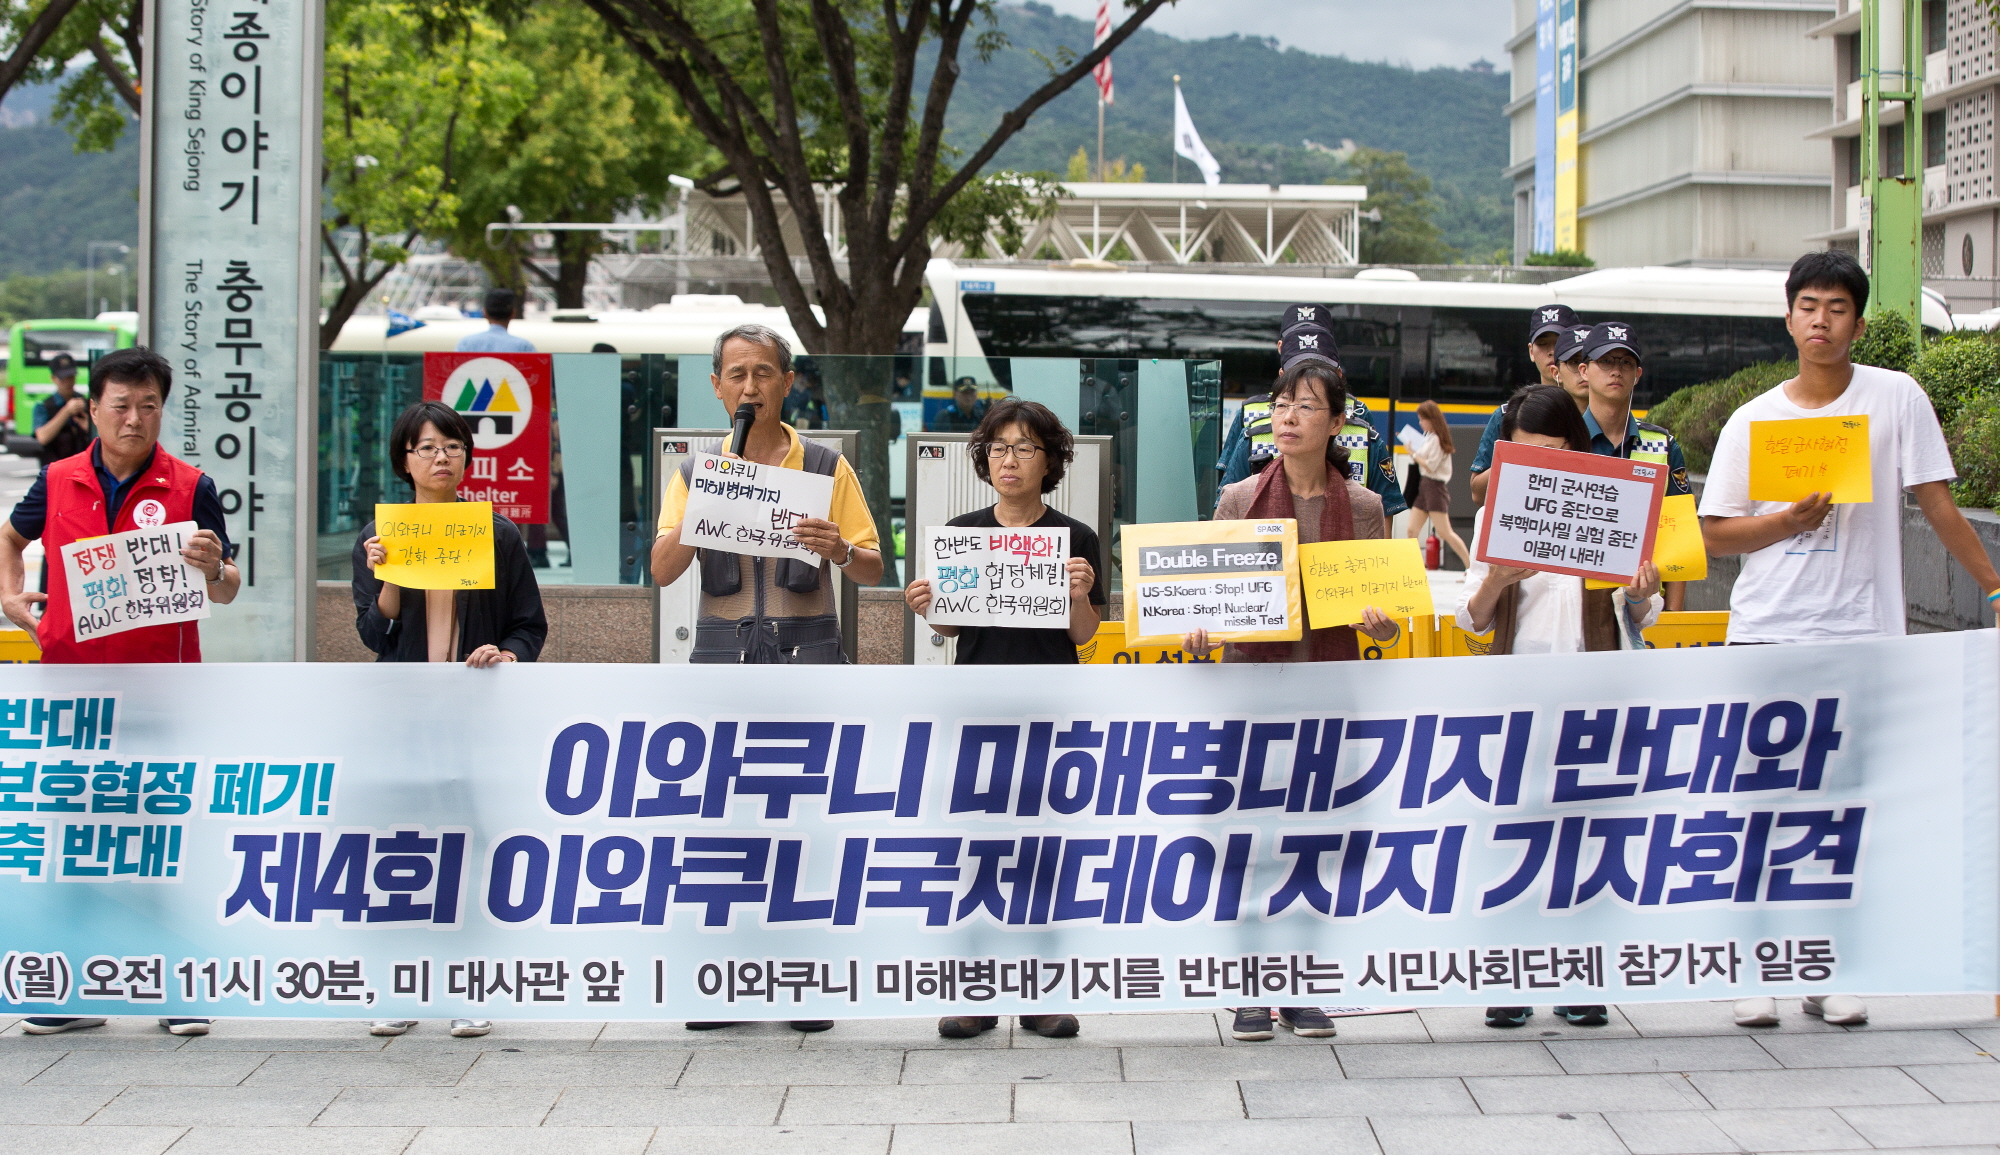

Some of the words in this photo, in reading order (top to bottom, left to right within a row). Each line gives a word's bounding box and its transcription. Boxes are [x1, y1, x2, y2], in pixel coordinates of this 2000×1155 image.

[190, 53, 207, 73] of
[185, 80, 206, 120] King
[219, 0, 269, 225] 종이야기
[183, 128, 205, 191] Sejong
[185, 259, 203, 294] The
[181, 301, 202, 352] Story
[184, 358, 201, 379] of
[183, 384, 201, 457] Admiral
[704, 458, 757, 481] 이와쿠니
[695, 478, 781, 504] 미해병대기지
[1528, 473, 1557, 494] 한미
[1561, 478, 1619, 502] 군사연습
[1525, 496, 1557, 515] UFG
[1561, 501, 1619, 523] 중단으로
[381, 521, 432, 539] 이와쿠니
[695, 518, 732, 539] AWC
[1257, 525, 1283, 533] SPARK
[1499, 513, 1571, 540] 북핵미사일
[1575, 525, 1604, 545] 실험
[1608, 529, 1638, 549] 중단
[72, 543, 117, 576] 전쟁
[399, 547, 427, 566] 강화
[934, 536, 982, 559] 한반도
[989, 533, 1062, 566] 비핵화!
[1145, 549, 1207, 570] Double
[1213, 548, 1278, 567] Freeze
[1523, 540, 1567, 560] 이끌어
[1569, 548, 1605, 567] 내라!
[82, 573, 127, 609] 평화
[133, 564, 187, 594] 정착!
[937, 565, 979, 593] 평화
[1214, 583, 1244, 597] Stop!
[1247, 581, 1273, 594] UFG
[78, 606, 122, 635] AWC
[125, 589, 204, 620] 한국위원회
[935, 595, 980, 614] AWC
[985, 593, 1065, 617] 한국위원회
[1193, 603, 1222, 617] Stop!
[1224, 615, 1256, 626] missile
[1259, 614, 1284, 626] Test
[0, 697, 116, 750] 반대!
[545, 720, 933, 819] 이와쿠니
[949, 711, 1534, 818] 미해병대기지
[1552, 697, 1842, 803] 반대와
[209, 762, 335, 816] 폐기!
[62, 824, 182, 877] 반대!
[224, 830, 467, 924] 제4회
[487, 833, 1254, 927] 이와쿠니국제데이
[1267, 825, 1468, 918] 지지
[1480, 807, 1866, 911] 기자회견
[3, 955, 70, 999] (월)
[83, 957, 163, 999] 오전
[178, 959, 261, 1002] 11시
[276, 960, 375, 1004] 30분,
[394, 960, 430, 1003] 미
[449, 960, 569, 1002] 대사관
[582, 960, 624, 1003] 앞
[698, 960, 858, 1003] 이와쿠니
[877, 957, 1165, 1003] 미해병대기지를
[1179, 955, 1344, 997] 반대하는
[1358, 946, 1604, 993] 시민사회단체
[1617, 941, 1741, 987] 참가자
[1755, 939, 1835, 982] 일동
